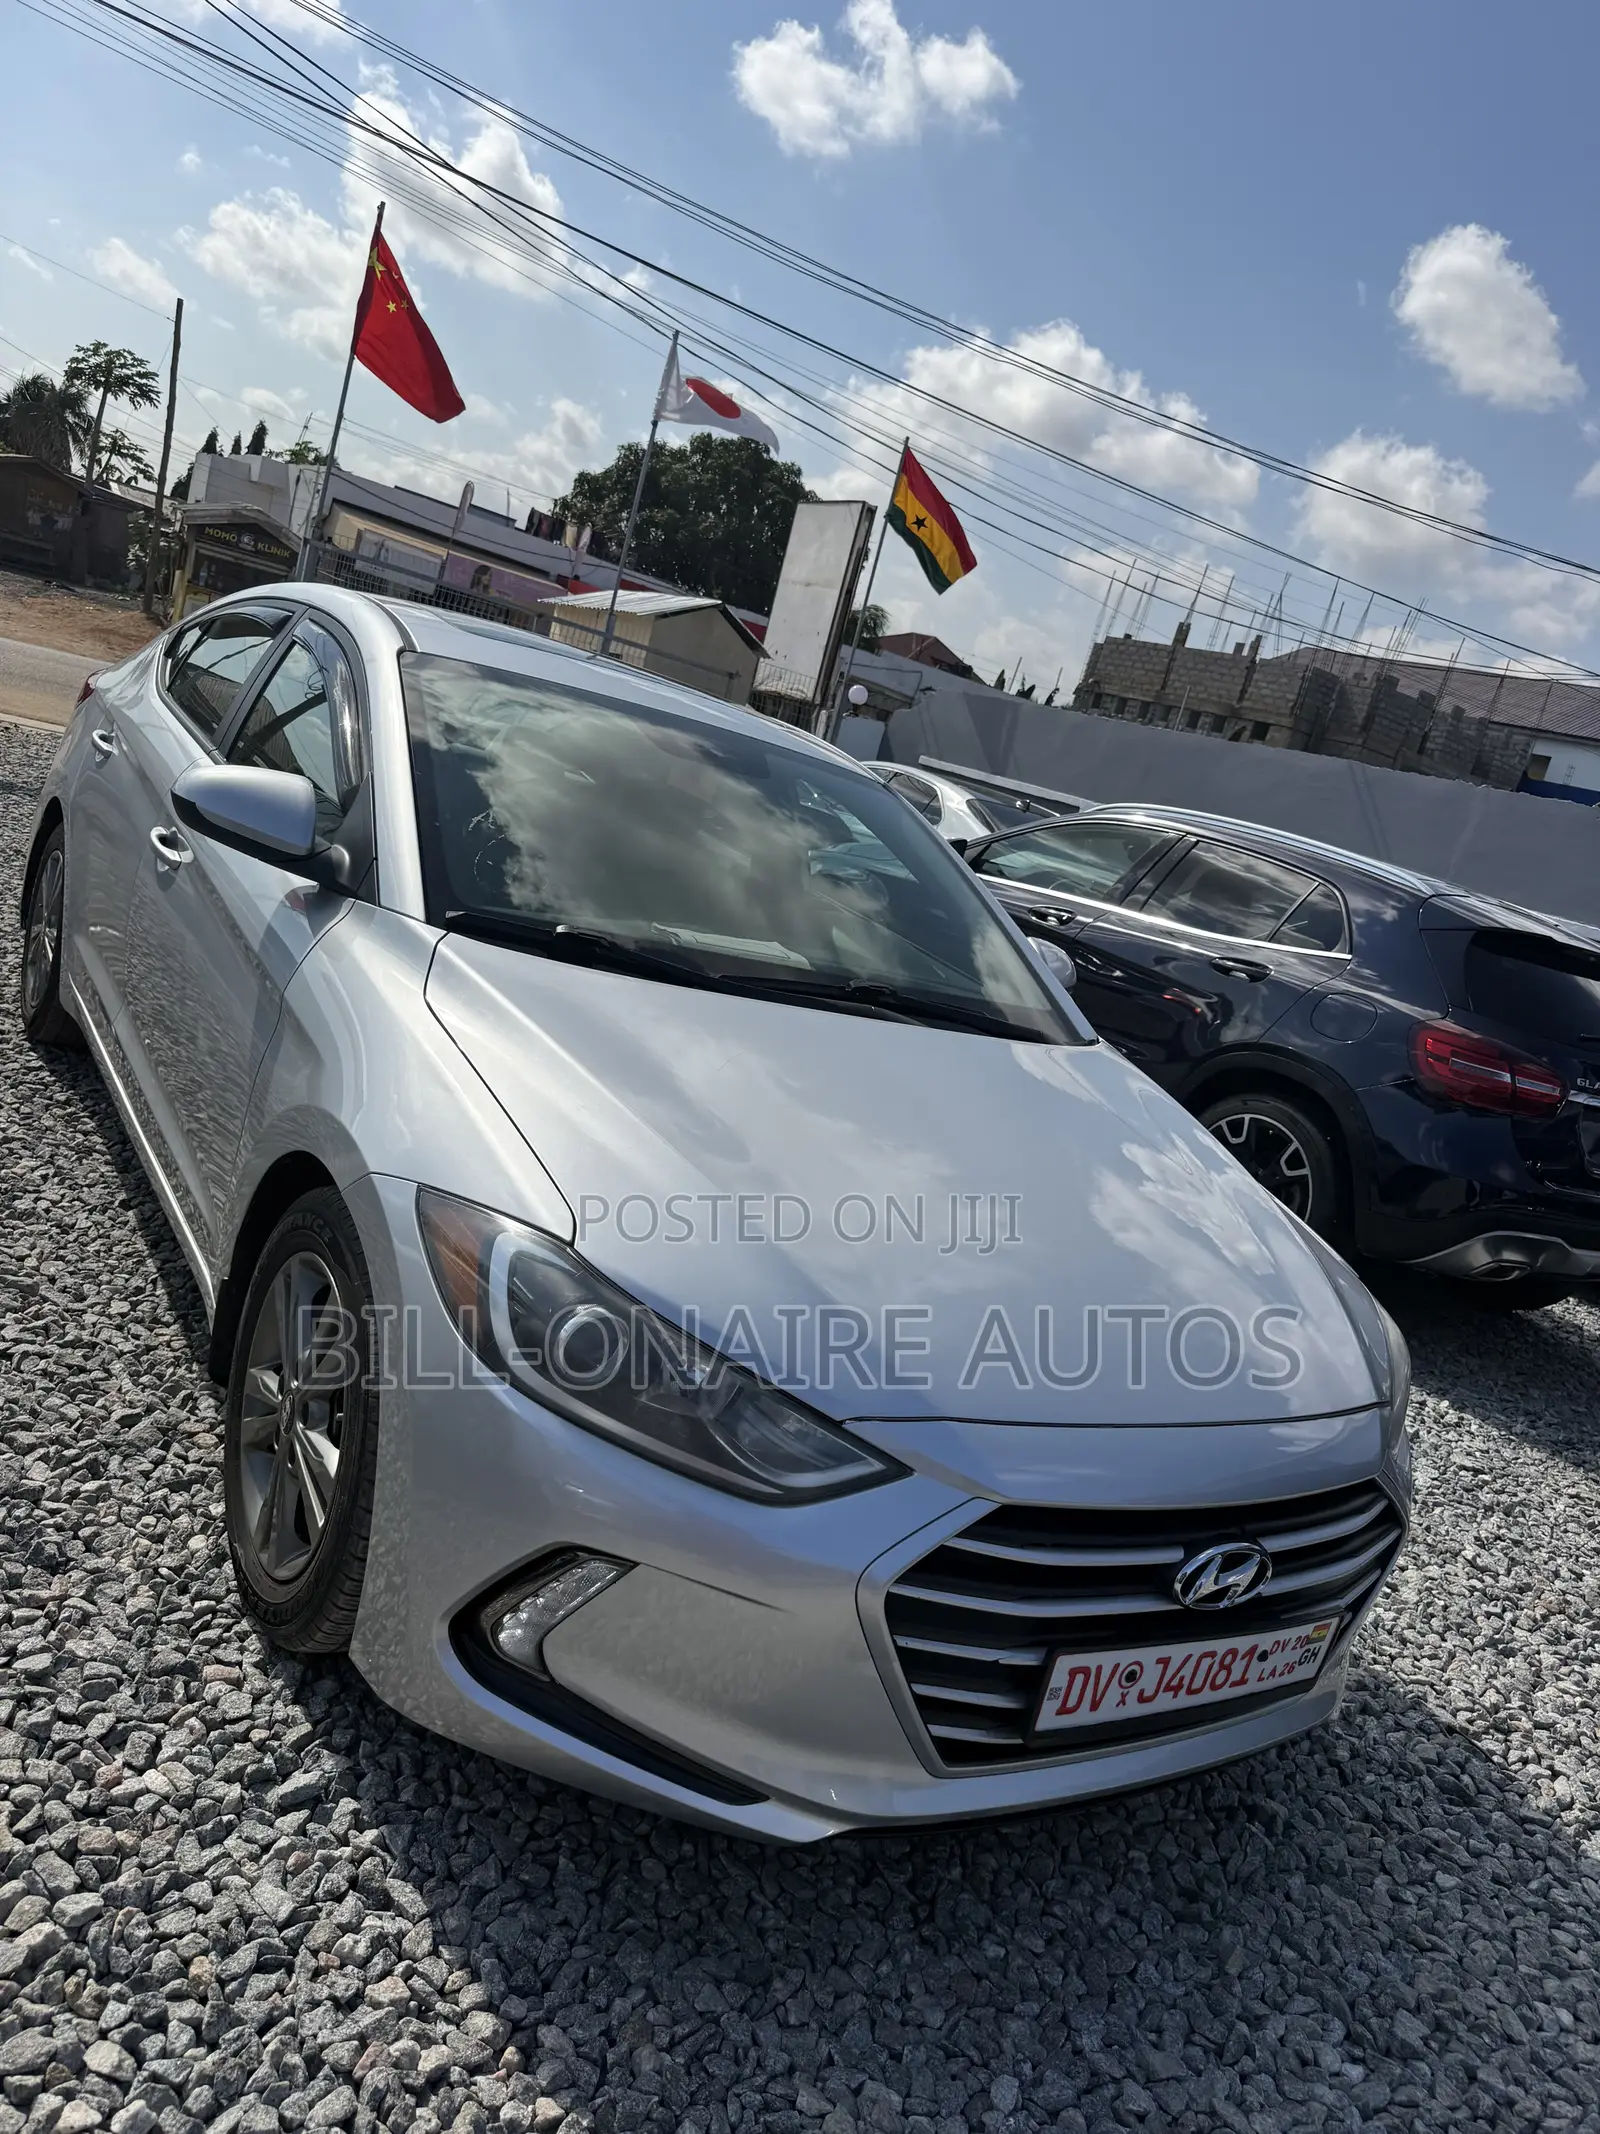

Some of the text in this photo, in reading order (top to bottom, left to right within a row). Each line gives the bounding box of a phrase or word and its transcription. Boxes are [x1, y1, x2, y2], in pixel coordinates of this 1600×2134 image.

[204, 526, 292, 558] MOMO KLINIK
[1298, 1645, 1322, 1667] GH
[1055, 1643, 1259, 1716] DV J4081
